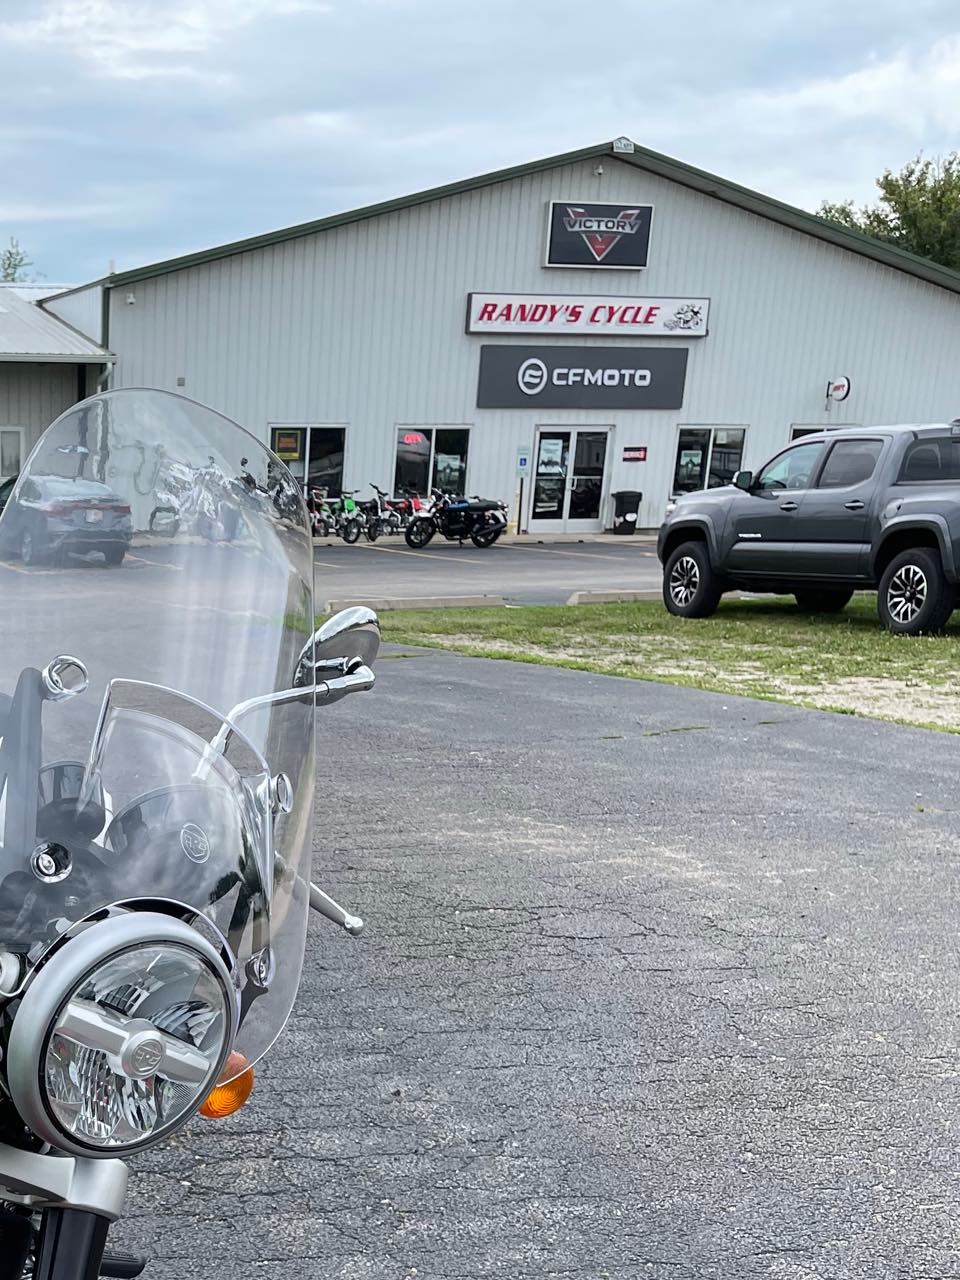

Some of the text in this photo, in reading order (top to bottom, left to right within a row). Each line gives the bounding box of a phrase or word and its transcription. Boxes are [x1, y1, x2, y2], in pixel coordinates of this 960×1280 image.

[567, 218, 640, 232] VICTORY
[478, 303, 660, 324] RANDY'S CYCLE
[552, 367, 651, 387] CFMOTO
